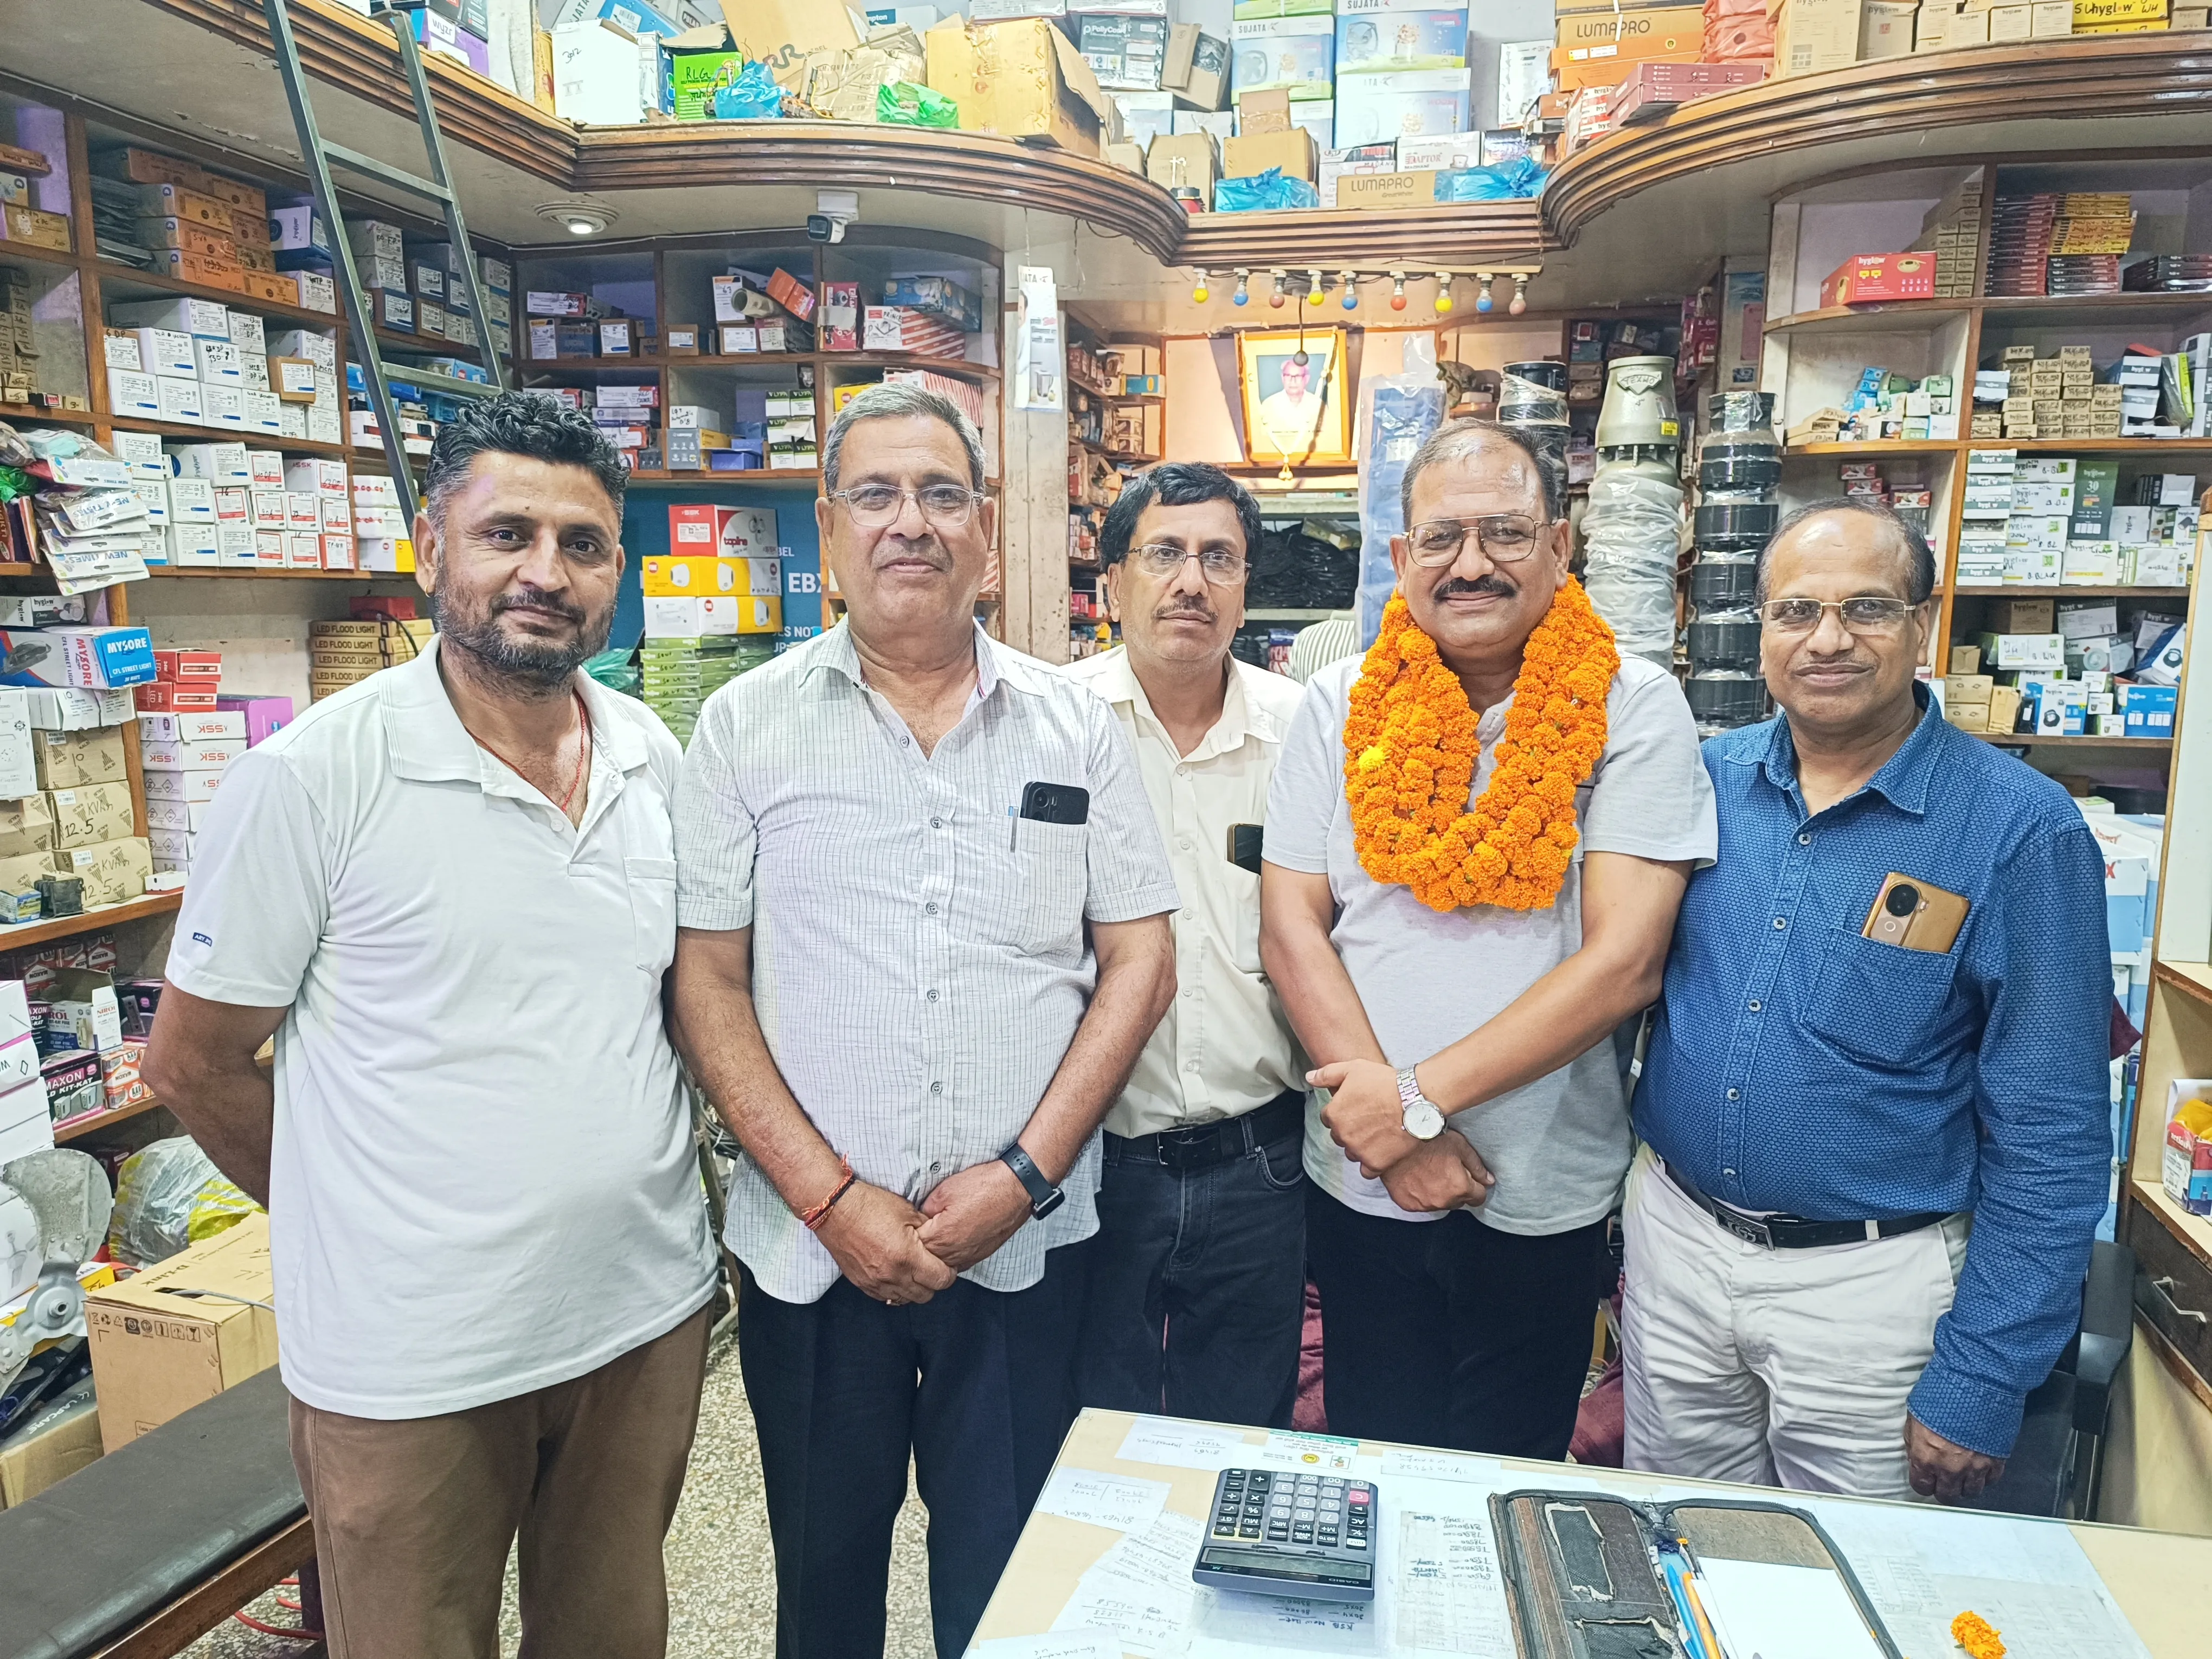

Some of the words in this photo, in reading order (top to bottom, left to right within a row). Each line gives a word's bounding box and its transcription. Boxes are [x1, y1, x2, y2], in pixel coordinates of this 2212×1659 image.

[1347, 0, 1379, 9] SUJATA
[1238, 25, 1267, 33] SUJATA
[1577, 19, 1651, 38] LUMAPRO
[1351, 176, 1414, 192] LUMAPRO
[724, 536, 748, 548] topline
[107, 637, 147, 654] MYSORE
[75, 638, 92, 686] MYSORE
[121, 664, 138, 674] STREET
[139, 662, 152, 671] LIGHT
[316, 672, 330, 680] LED
[317, 687, 330, 696] LED
[55, 756, 68, 766] KALSI
[65, 818, 94, 838] 12.5
[49, 1011, 70, 1020] ROL
[97, 1005, 117, 1015] NIROL
[46, 1071, 82, 1091] MAXON
[59, 1077, 93, 1094] KIT-KAT
[27, 1399, 78, 1435] LAPCARE
